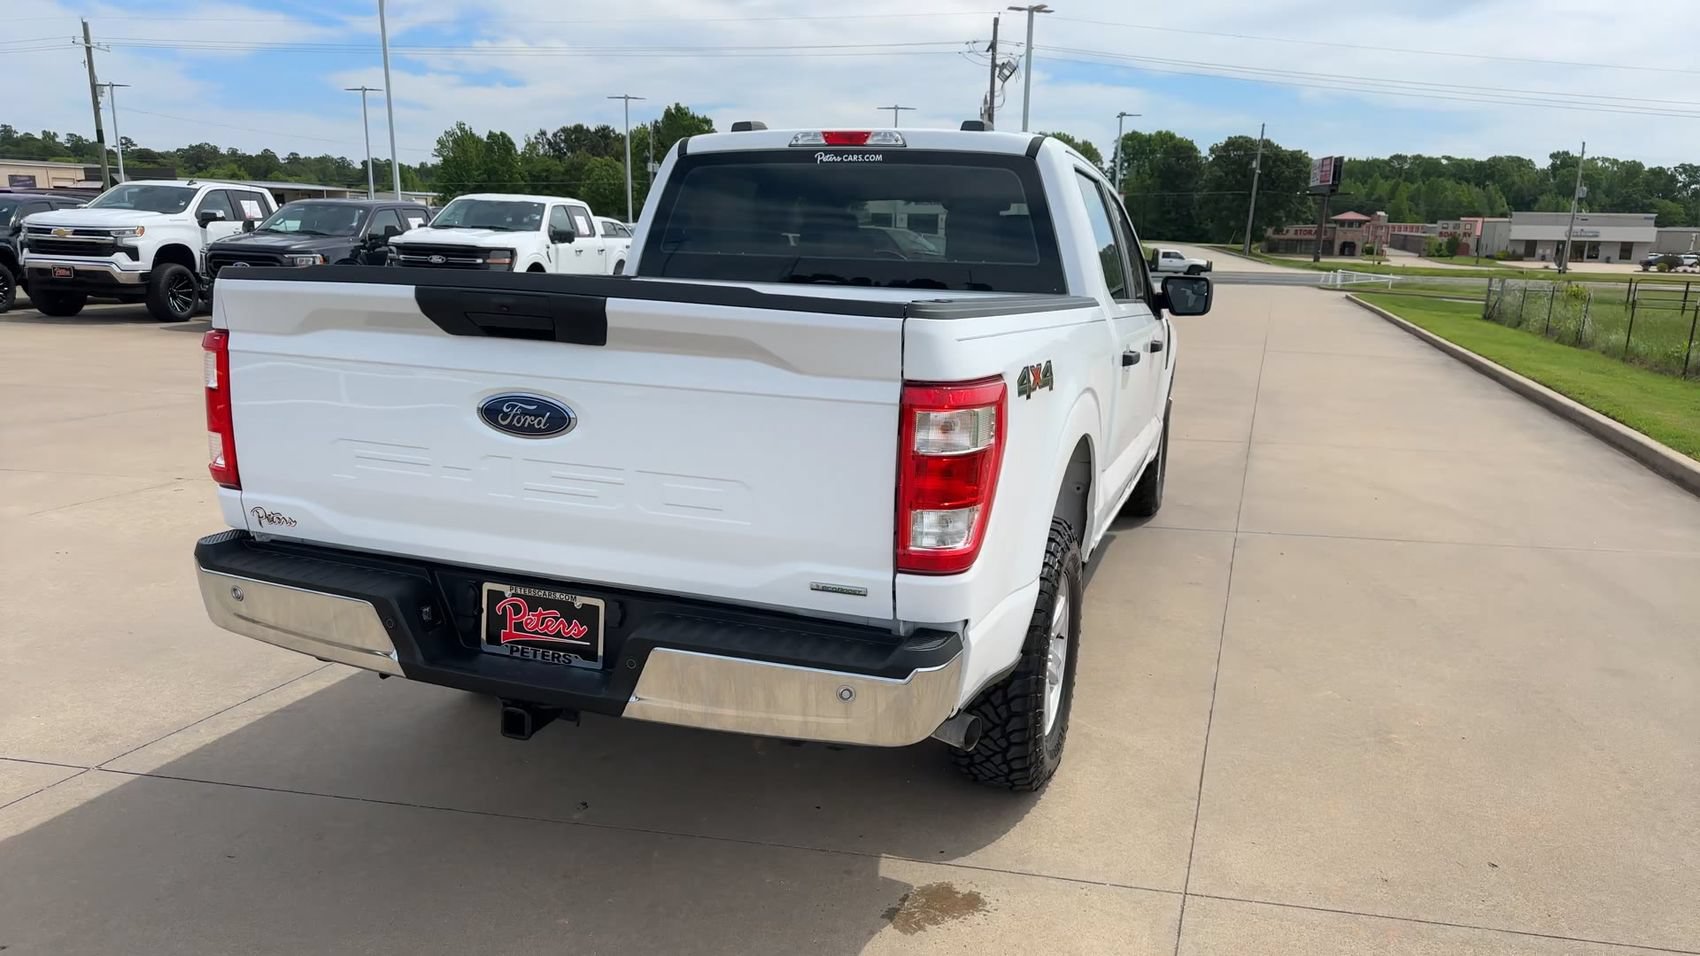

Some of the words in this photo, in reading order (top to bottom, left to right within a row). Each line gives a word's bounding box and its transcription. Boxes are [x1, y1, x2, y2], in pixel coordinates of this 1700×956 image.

[498, 401, 551, 429] Ford
[509, 586, 577, 602] PETERSCARS.COM
[496, 597, 588, 643] Peters
[509, 645, 573, 665] PETERS
